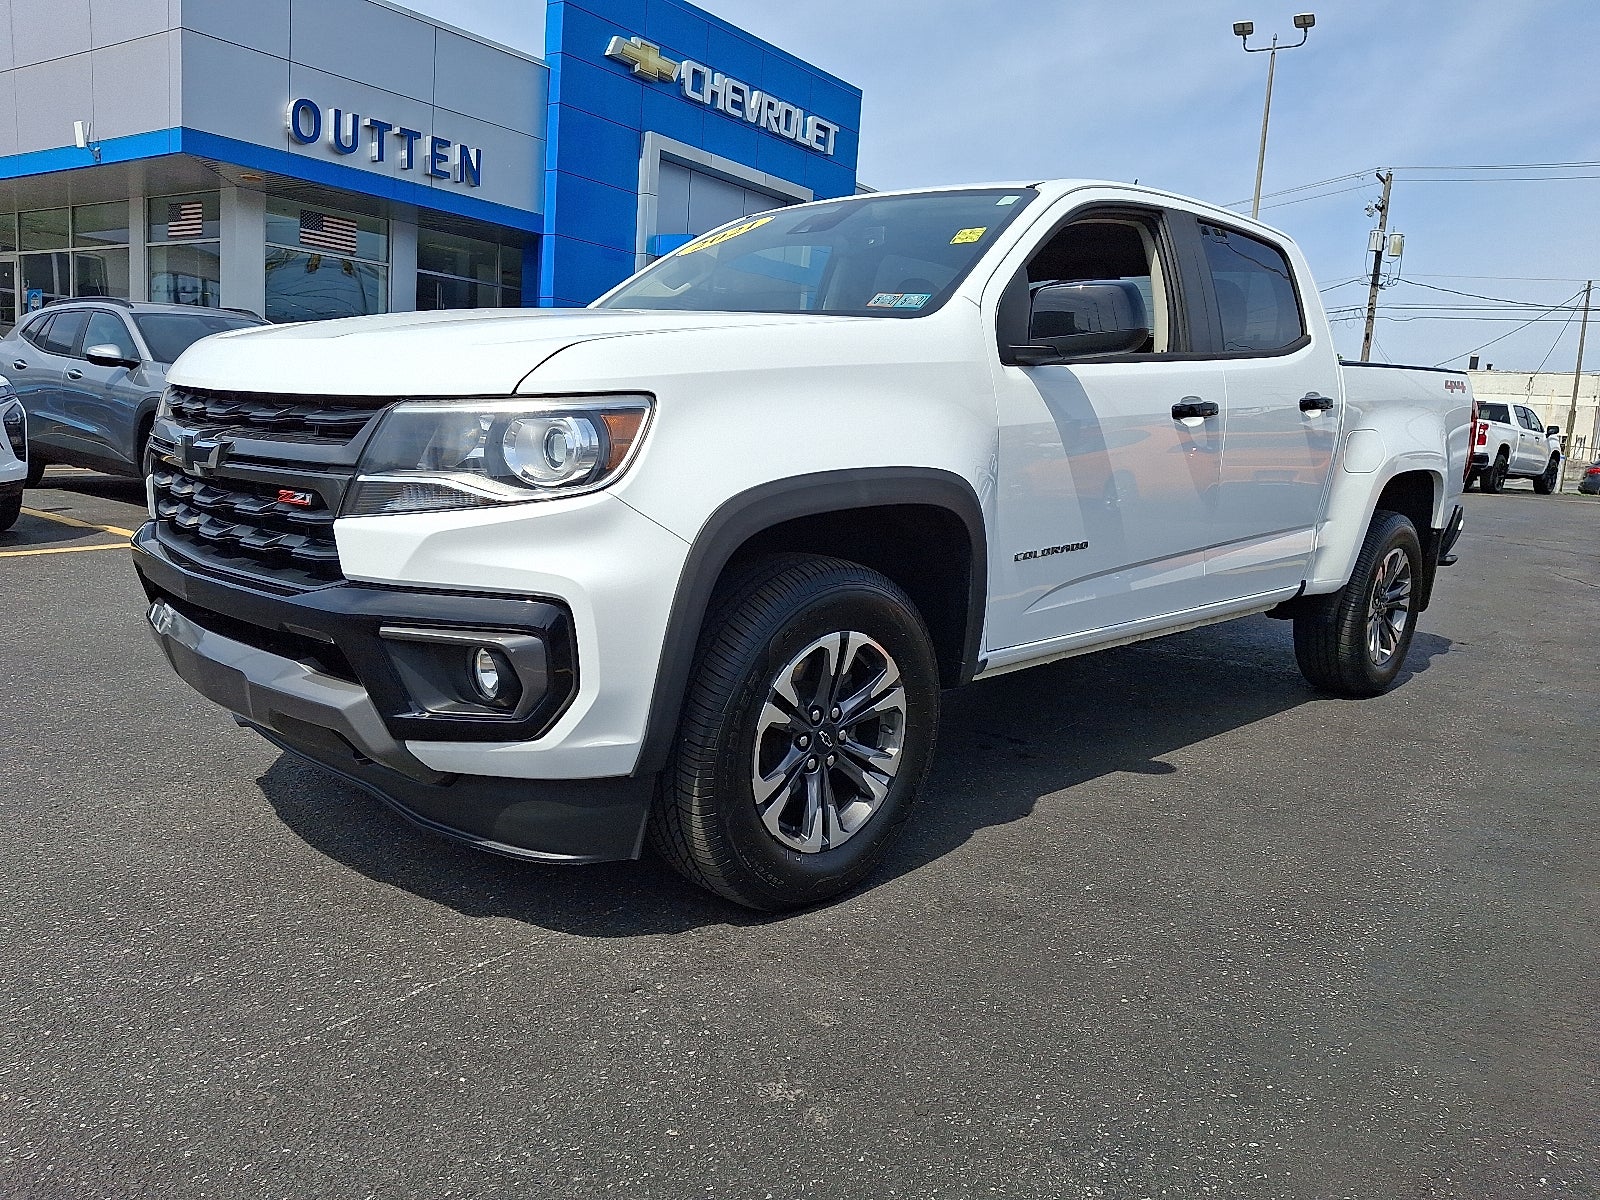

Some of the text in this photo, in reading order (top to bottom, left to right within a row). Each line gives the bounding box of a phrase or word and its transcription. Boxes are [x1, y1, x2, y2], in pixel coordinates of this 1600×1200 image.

[287, 98, 482, 187] OUTTEN
[681, 60, 839, 155] CHEVROLET
[1013, 540, 1089, 562] COLORADO
